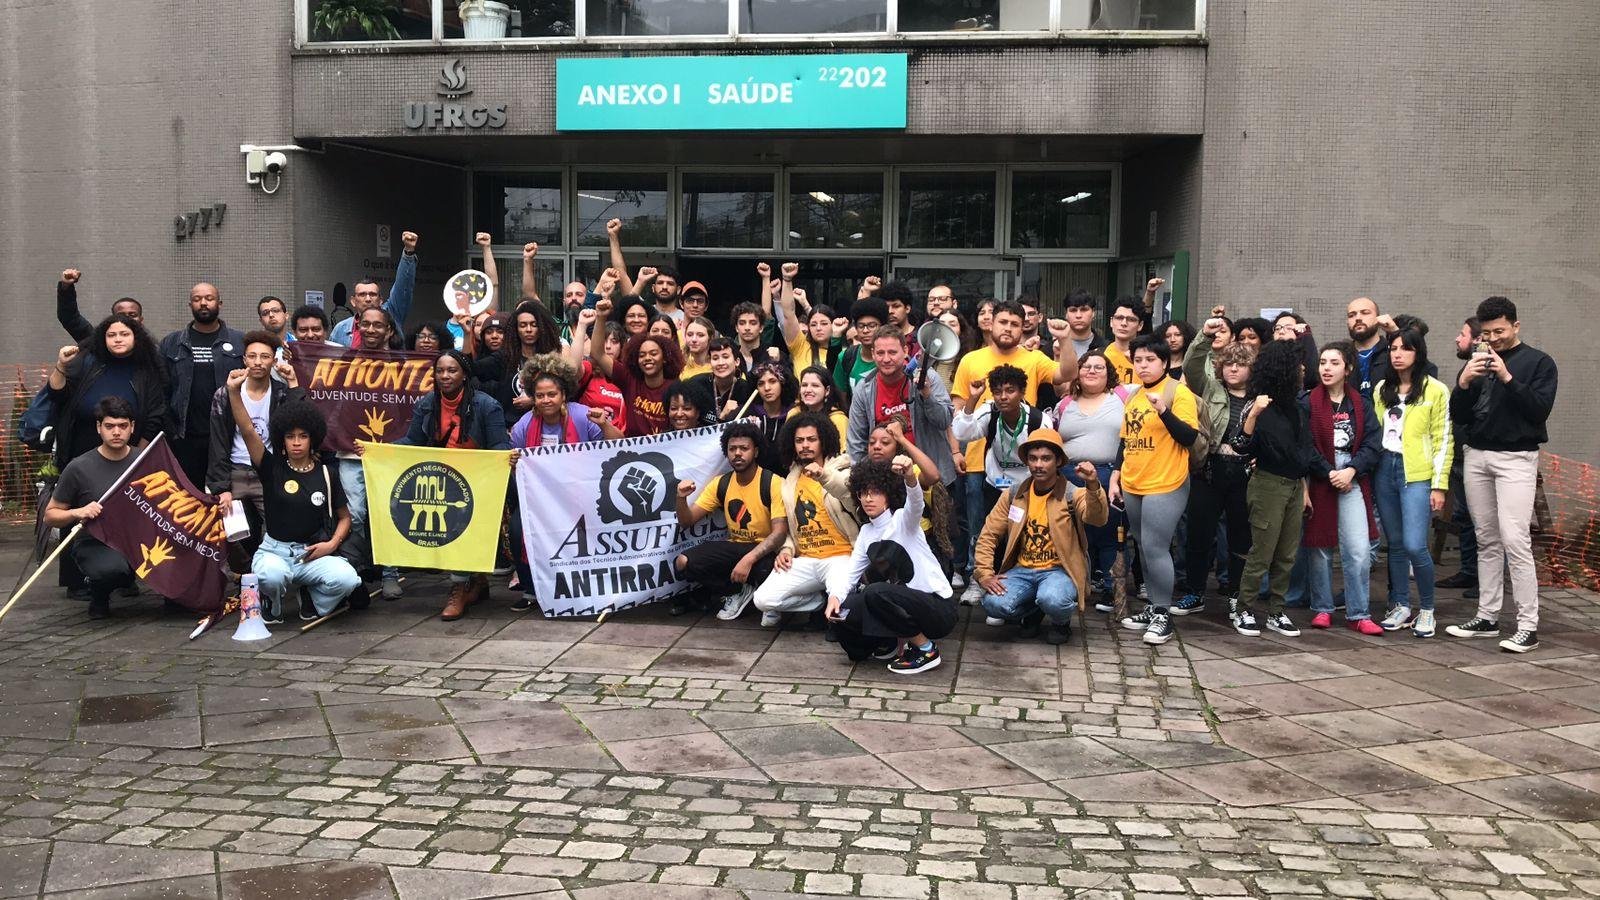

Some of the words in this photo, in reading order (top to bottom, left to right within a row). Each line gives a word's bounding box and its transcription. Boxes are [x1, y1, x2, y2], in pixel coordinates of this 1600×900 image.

[577, 84, 667, 105] ANEXO
[673, 84, 681, 104] I
[707, 77, 793, 104] SAÚDE
[405, 103, 507, 129] UFRGS
[174, 203, 227, 238] 2777
[310, 389, 378, 403] JUVENTUDE
[381, 393, 406, 404] SEM
[394, 467, 422, 499] MOVIMENTO
[423, 465, 447, 474] NEGRO
[447, 471, 470, 501] UNIFICADO
[124, 486, 176, 535] JUVENTUDE
[173, 531, 194, 549] SEM
[550, 557, 579, 568] Sindicato
[579, 558, 591, 566] dos
